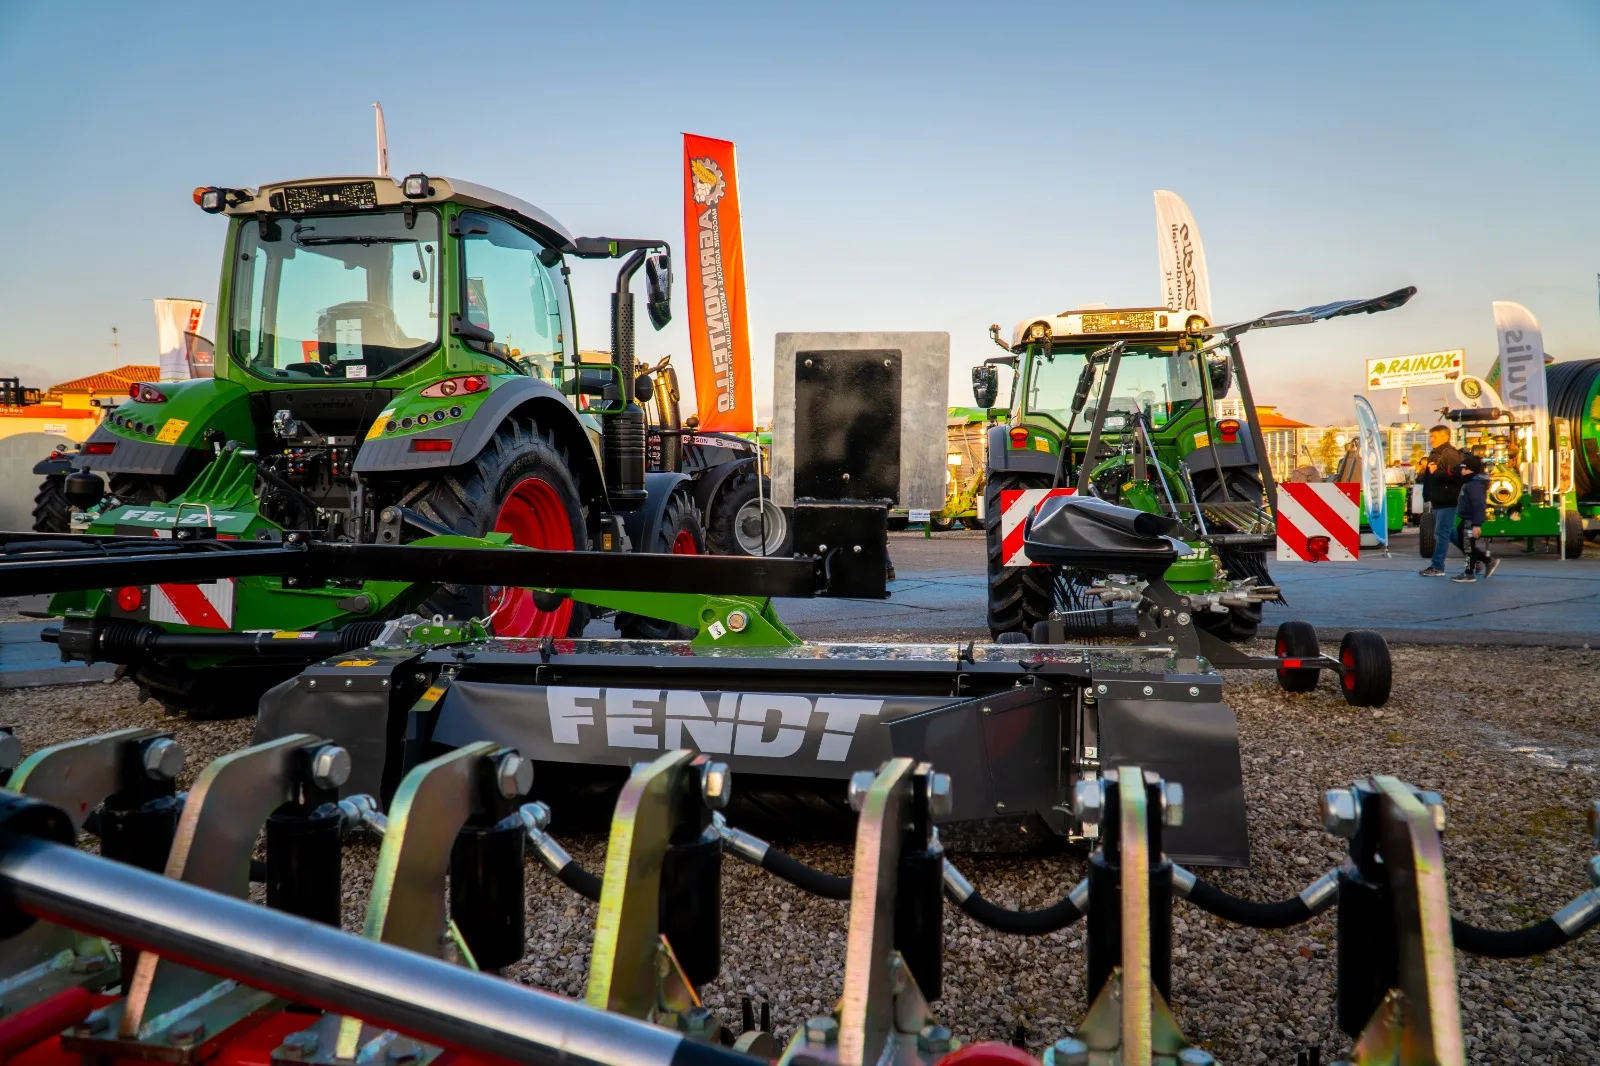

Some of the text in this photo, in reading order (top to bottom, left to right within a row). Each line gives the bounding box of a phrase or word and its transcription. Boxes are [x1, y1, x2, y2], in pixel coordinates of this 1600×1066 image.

[1387, 353, 1457, 374] RAINOX
[119, 509, 237, 524] FENDT
[546, 686, 884, 762] FENDT
